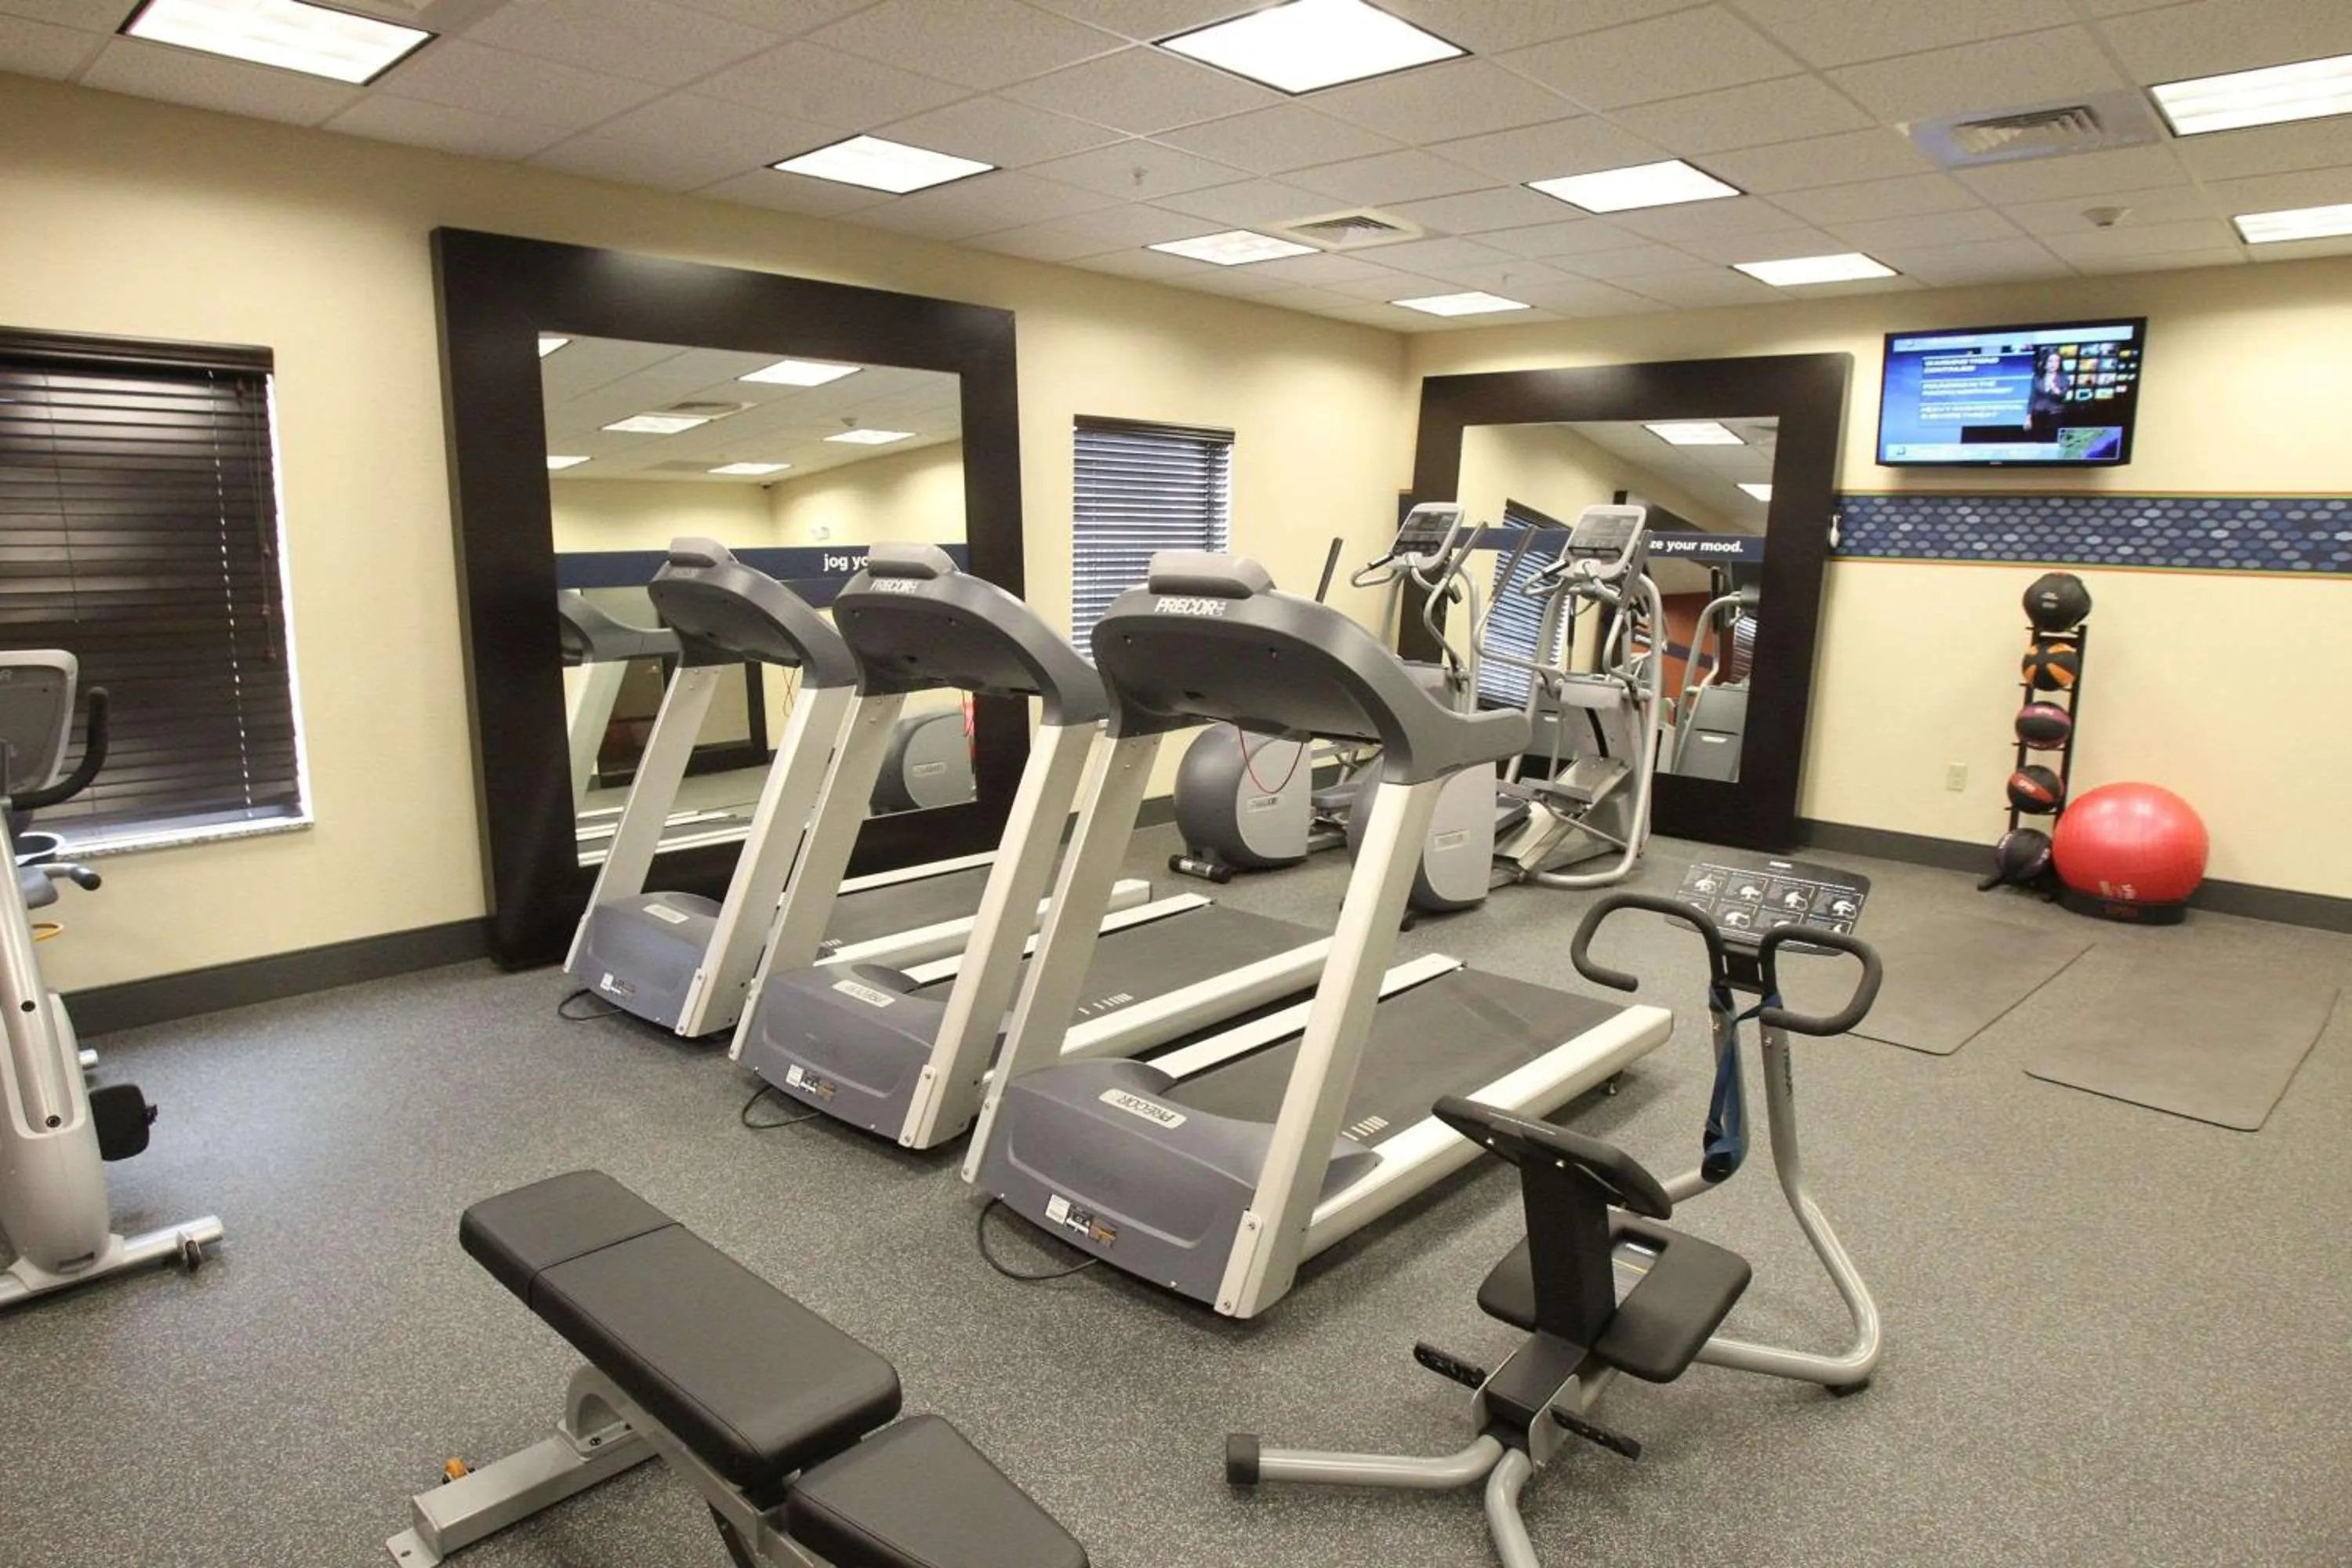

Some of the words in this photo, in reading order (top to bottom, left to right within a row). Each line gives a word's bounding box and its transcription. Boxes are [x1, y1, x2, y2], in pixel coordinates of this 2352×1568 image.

[1666, 540, 1698, 553] your
[1700, 540, 1744, 553] mood.
[823, 553, 848, 572] jog
[1155, 597, 1219, 615] PRECOR
